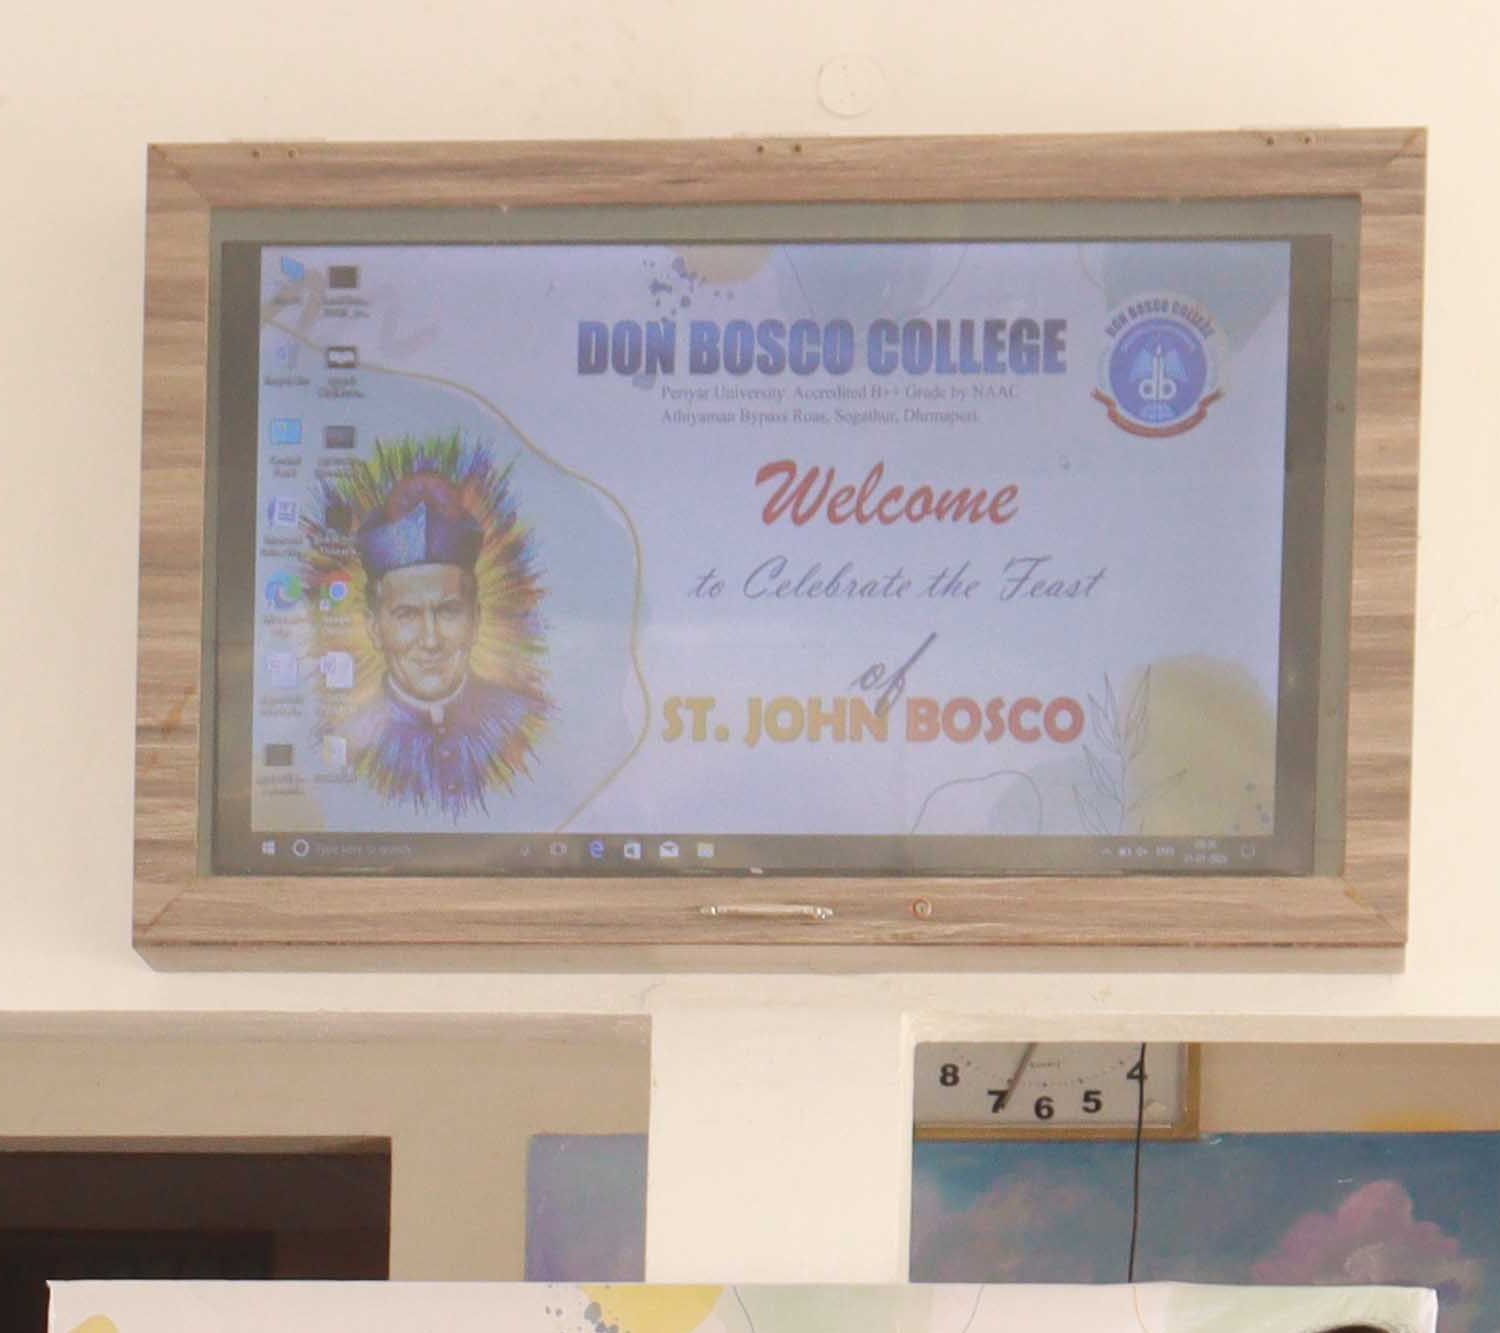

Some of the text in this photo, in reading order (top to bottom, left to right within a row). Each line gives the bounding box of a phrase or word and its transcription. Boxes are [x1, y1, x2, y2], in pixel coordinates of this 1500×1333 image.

[577, 317, 1068, 377] DON BOSCO COLLEGE
[714, 384, 786, 404] University
[794, 384, 866, 400] Accredited
[904, 384, 947, 400] Grade
[971, 384, 1018, 400] NAAC
[754, 458, 1019, 527] Welcome
[688, 555, 1108, 600] to Celebrate the Feast
[850, 631, 939, 719] of
[661, 695, 1086, 748] ST. JOHN BOSCO
[938, 1062, 961, 1088] 8
[1125, 1060, 1148, 1082] 4
[986, 1088, 1011, 1114] 7
[1033, 1095, 1056, 1121] 6
[1081, 1089, 1103, 1114] 5
